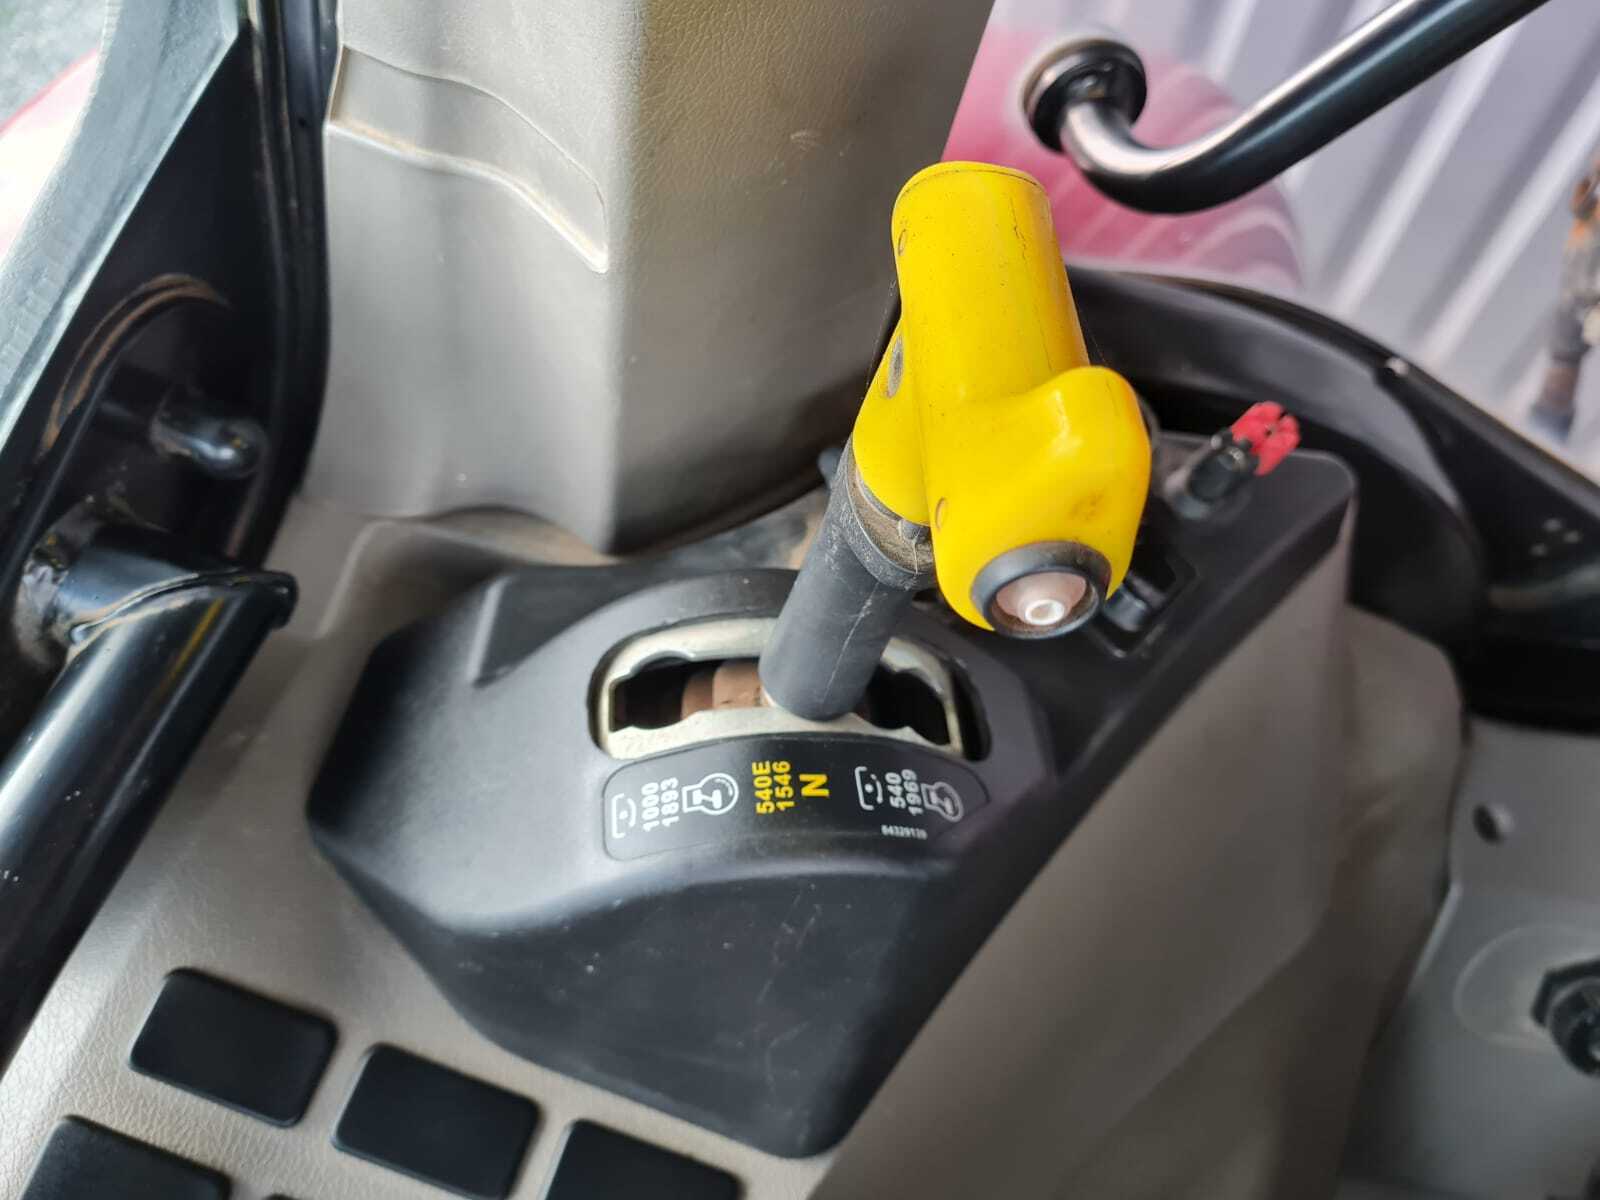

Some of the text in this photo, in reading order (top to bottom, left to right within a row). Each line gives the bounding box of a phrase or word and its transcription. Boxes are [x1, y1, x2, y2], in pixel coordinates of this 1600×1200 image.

[641, 782, 660, 831] 1000
[660, 777, 679, 827] 1893
[752, 760, 775, 814] 540E
[772, 761, 795, 811] 1546
[799, 773, 830, 798] N
[885, 772, 906, 809] 540
[901, 769, 923, 816] 1969
